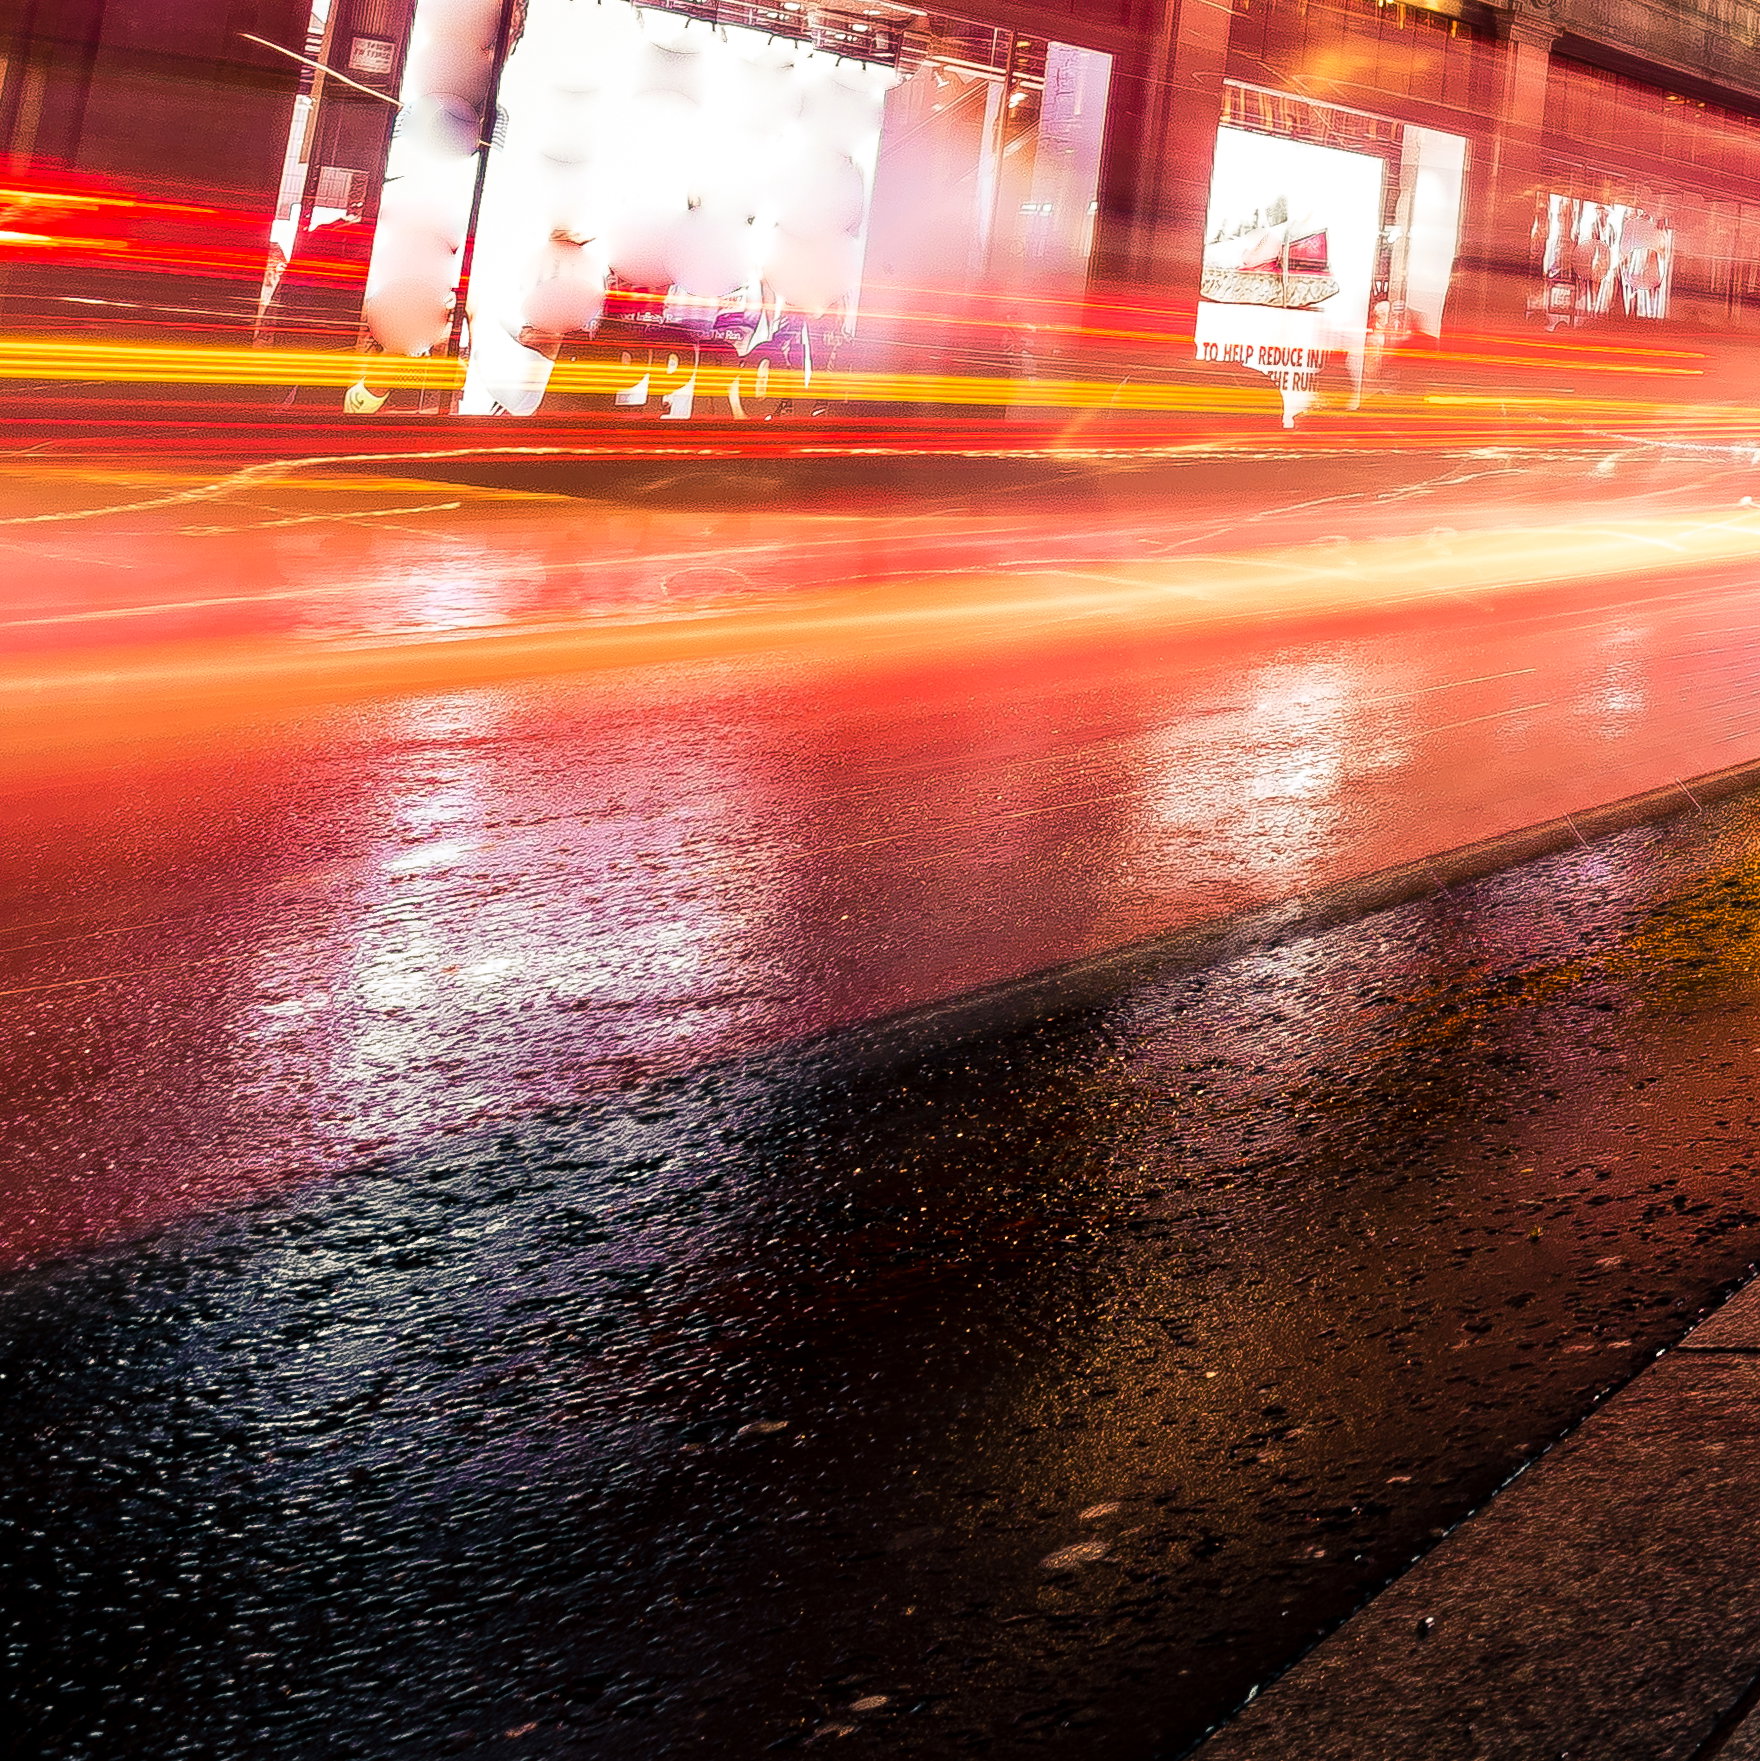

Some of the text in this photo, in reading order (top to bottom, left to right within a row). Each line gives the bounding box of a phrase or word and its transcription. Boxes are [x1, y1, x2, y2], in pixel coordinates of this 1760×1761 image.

[1203, 342, 1218, 362] TO
[1223, 344, 1254, 365] HELP
[1259, 346, 1303, 368] REDUCE
